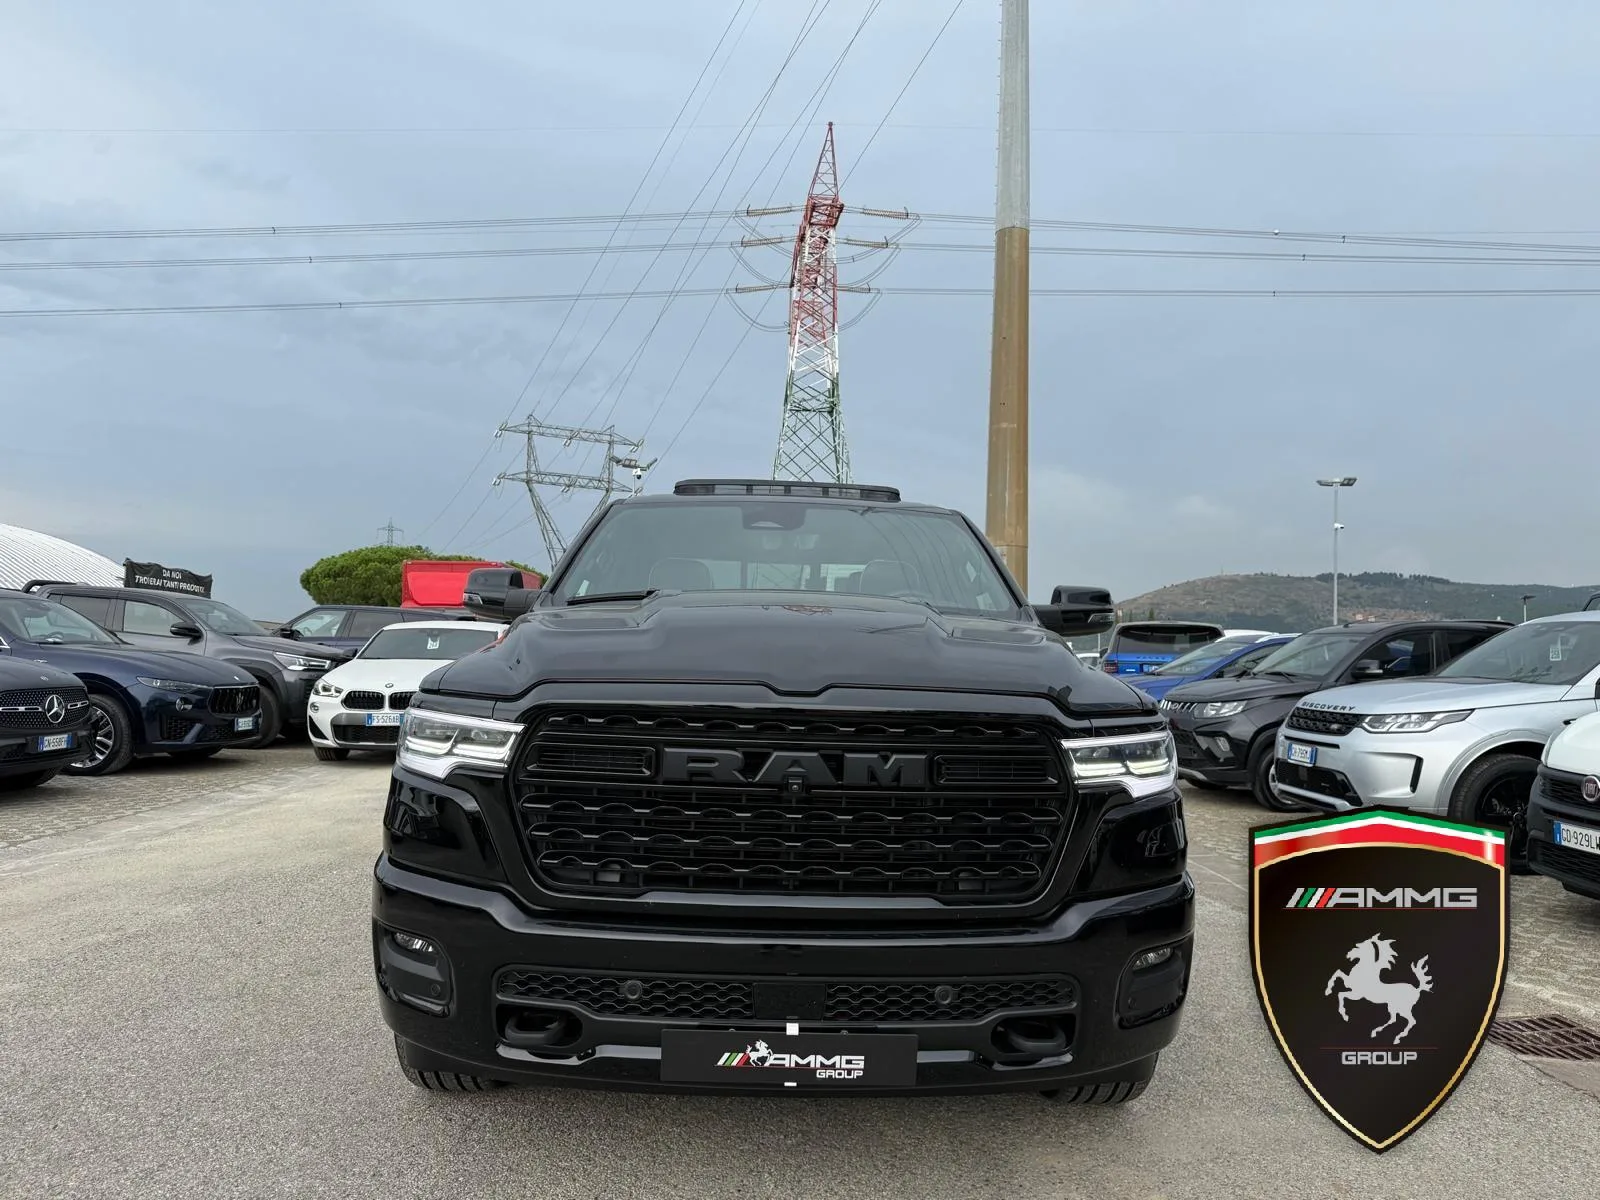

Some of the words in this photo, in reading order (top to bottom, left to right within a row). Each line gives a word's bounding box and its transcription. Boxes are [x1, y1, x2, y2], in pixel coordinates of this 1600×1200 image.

[162, 569, 170, 578] DA
[171, 571, 182, 580] NOI
[1301, 701, 1355, 712] DISCOVERY
[662, 747, 928, 787] RAM
[816, 1069, 864, 1079] GROUP
